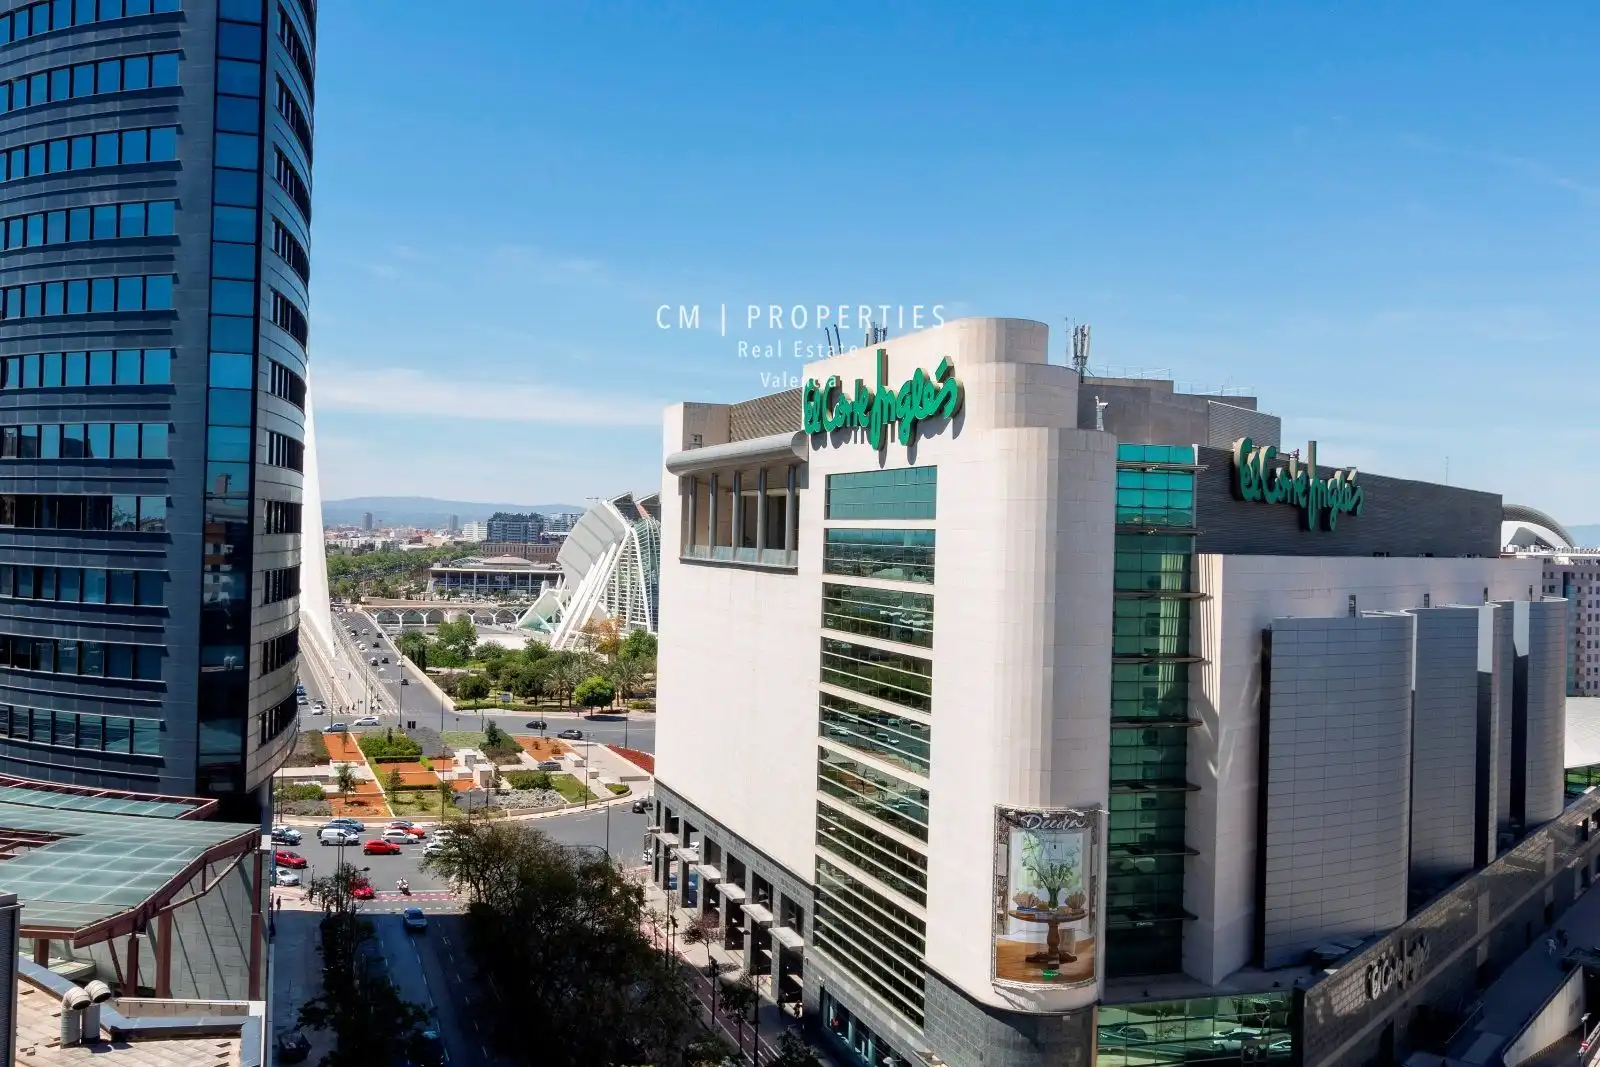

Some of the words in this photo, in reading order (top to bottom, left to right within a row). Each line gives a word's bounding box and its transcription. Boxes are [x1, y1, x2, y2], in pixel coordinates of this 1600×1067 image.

[804, 378, 822, 434] El
[823, 375, 873, 432] Corte
[870, 349, 962, 450] Inglés
[1233, 437, 1261, 501] El
